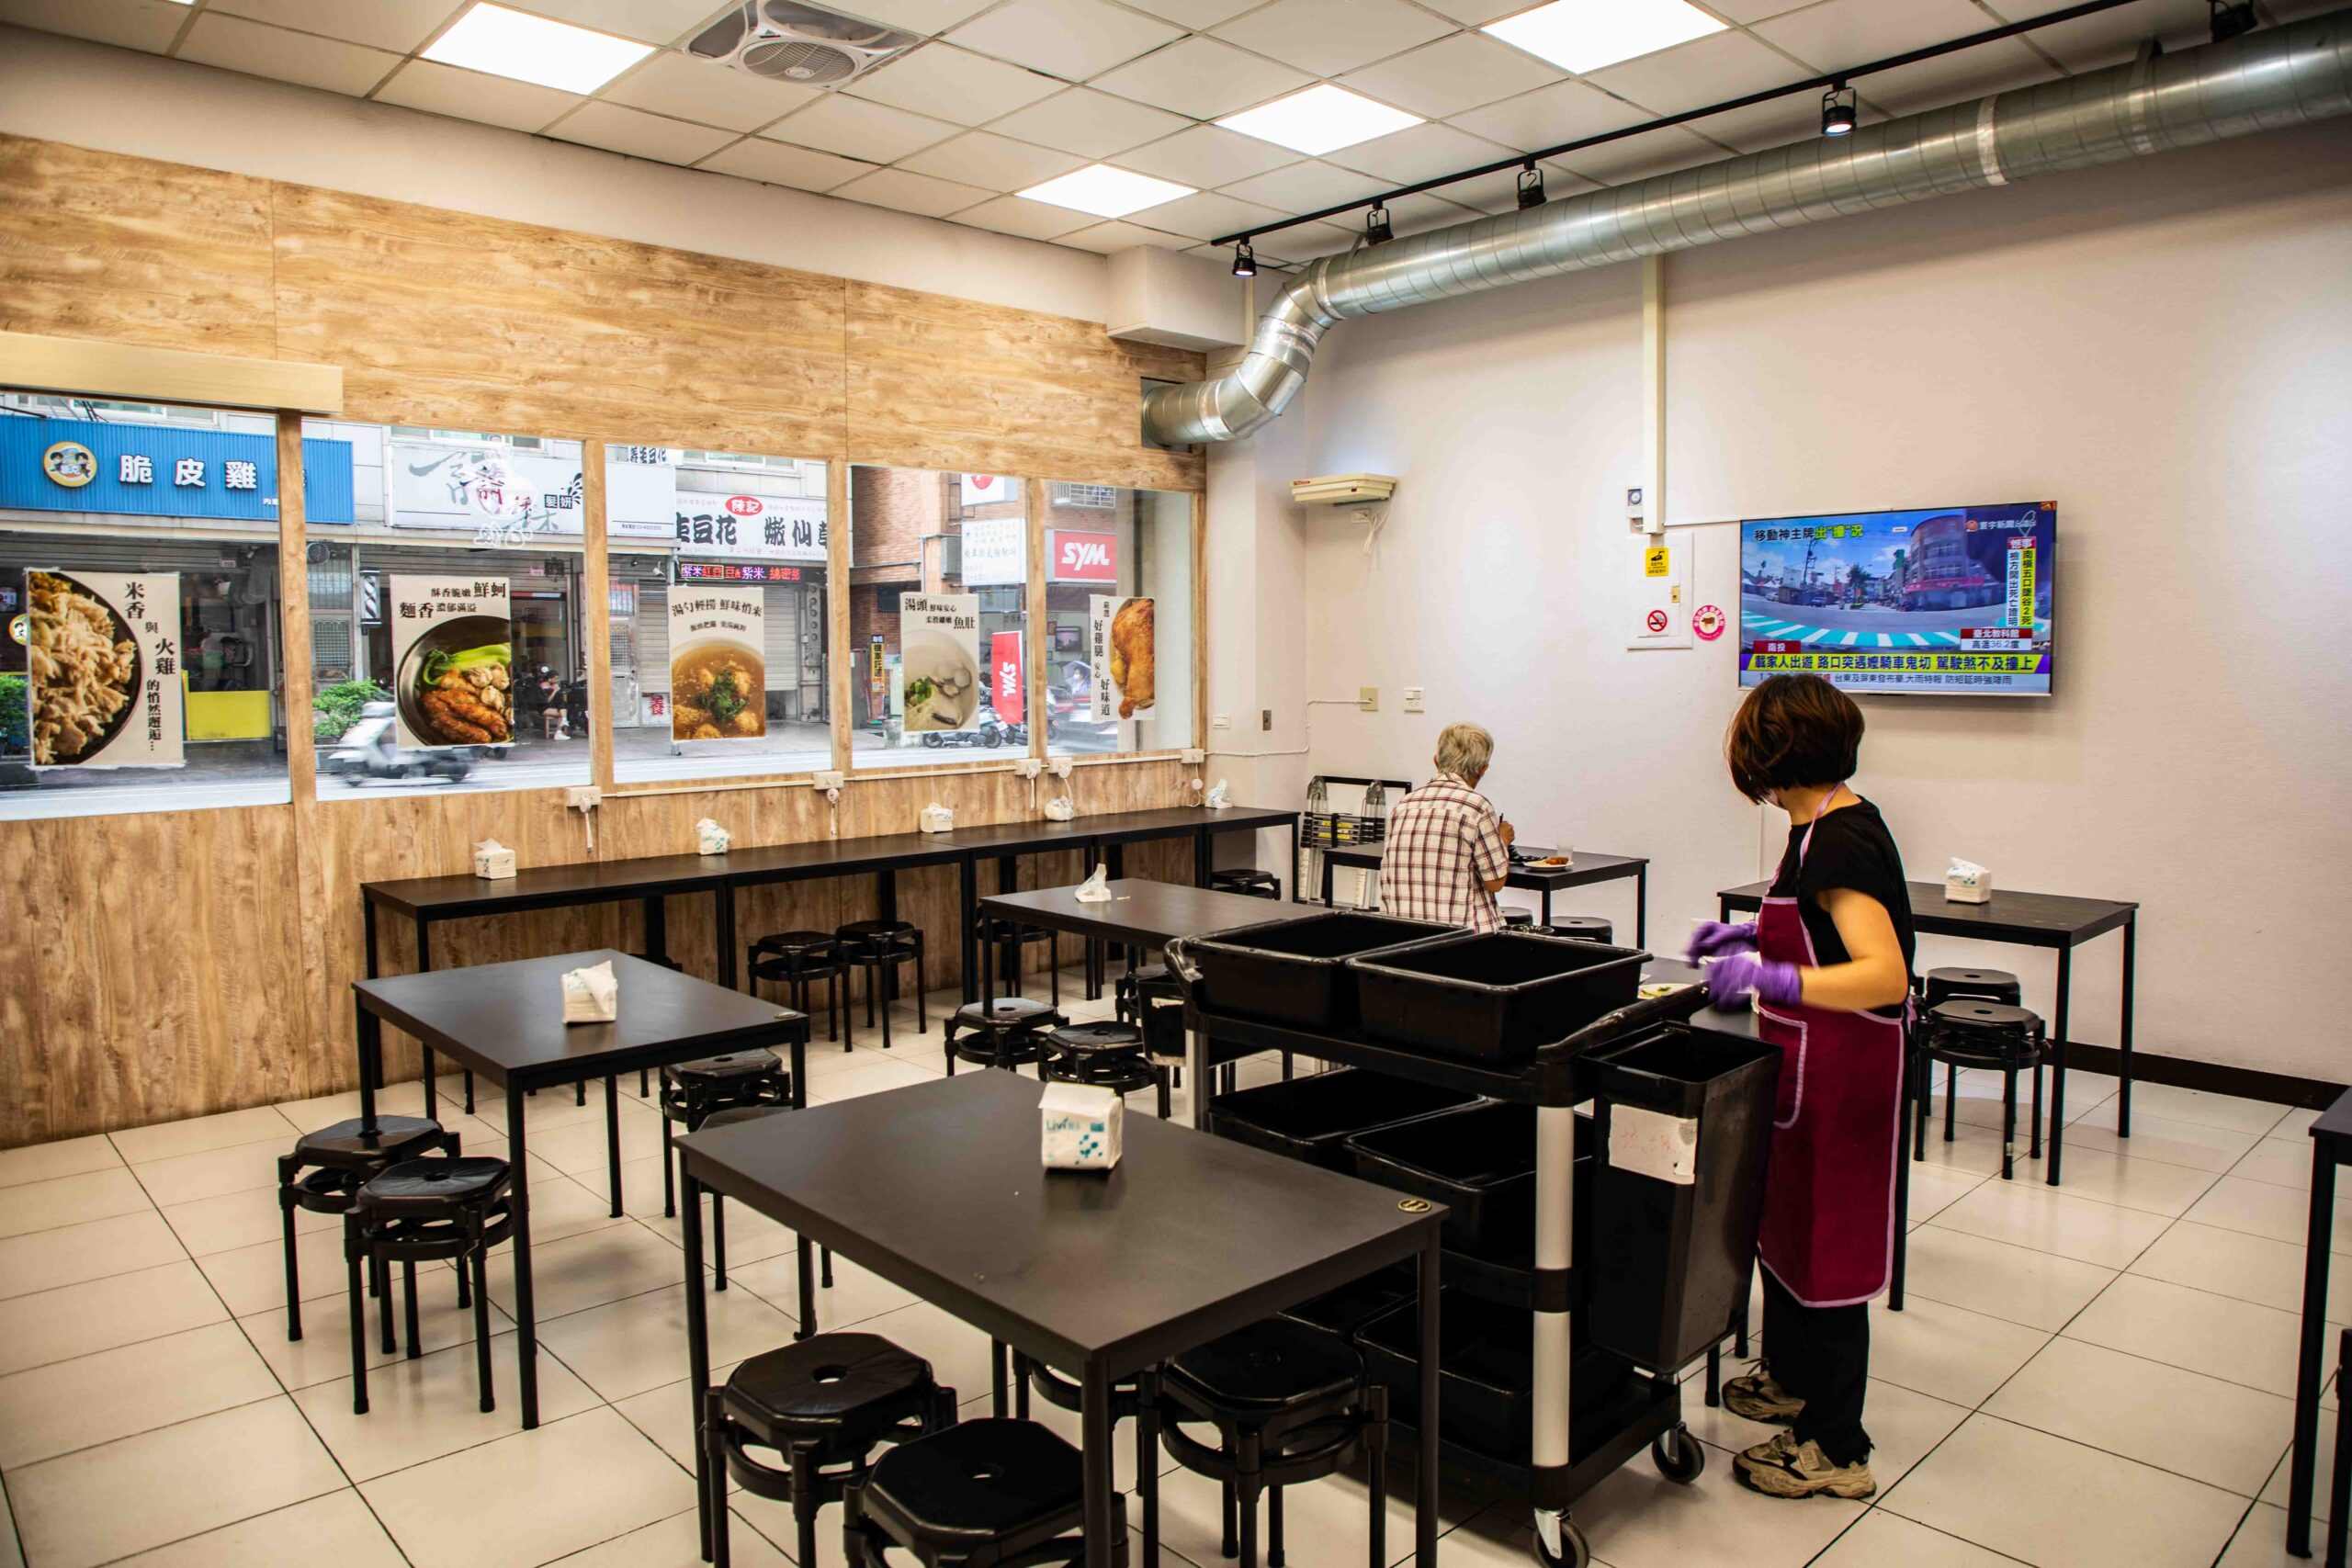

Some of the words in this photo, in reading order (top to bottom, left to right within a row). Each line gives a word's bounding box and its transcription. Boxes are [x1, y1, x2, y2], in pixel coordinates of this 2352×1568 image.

[119, 455, 309, 490] 脆皮雞
[731, 499, 759, 513] 陳記
[1061, 542, 1110, 571] SYM
[473, 581, 506, 599] 鮮蚵
[125, 581, 146, 619] 米香
[905, 598, 928, 613] 湯頭
[400, 602, 434, 618] 麵香
[145, 622, 158, 634] 與
[954, 616, 976, 629] 魚肚
[154, 637, 175, 676] 火雞
[1767, 643, 1786, 652] 南投
[999, 662, 1017, 697] SYM
[1101, 679, 1111, 716] 好味道
